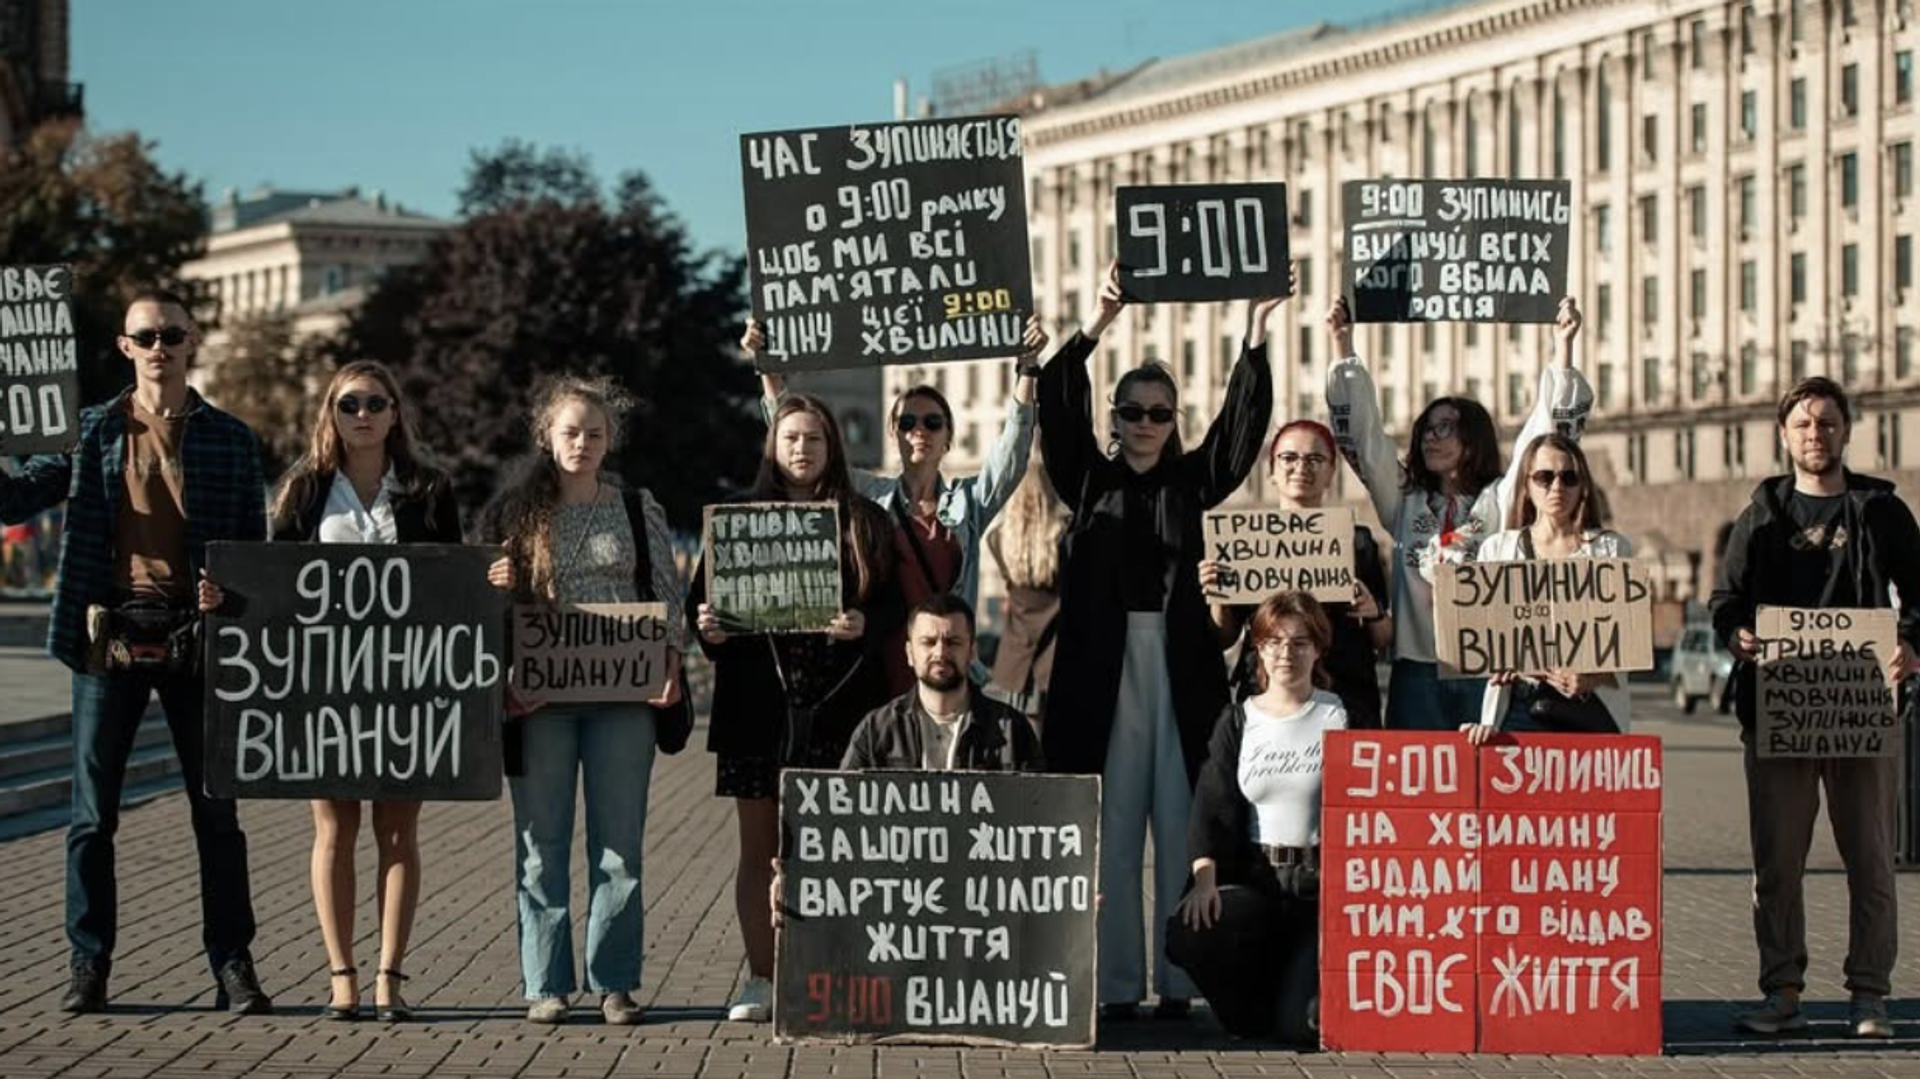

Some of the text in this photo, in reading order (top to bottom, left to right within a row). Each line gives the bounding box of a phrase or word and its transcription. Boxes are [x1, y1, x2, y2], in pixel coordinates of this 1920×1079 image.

[750, 118, 1023, 179] ЧАС ЗУПИНЯЄТЬСЯ
[838, 177, 911, 228] 9:00
[1361, 184, 1569, 225] 9:00 ЗУПИНИСЬ
[758, 241, 821, 277] ЩОБ
[833, 233, 888, 268] МИ
[1129, 198, 1268, 278] 9:00
[1352, 226, 1552, 263] ВШАНУЙ ВСІХ
[1355, 261, 1550, 295] КОГО ВБИЛА
[943, 289, 1011, 315] 9:00
[1409, 295, 1494, 320] РОСІЯ
[767, 312, 1021, 362] ЦІНУ ХВИЛИНИ
[711, 510, 822, 539] ТРИВАЄ
[1208, 512, 1325, 535] ТРИВАЄ
[1215, 538, 1341, 562] ХВИЛИНА
[296, 556, 411, 624] 9:00
[1217, 566, 1351, 594] МОВЧАННЯ
[1453, 560, 1647, 607] ЗУПИНИСЬ
[520, 613, 667, 648] ЗУПИНИСЬ
[1790, 611, 1852, 630] 9:00
[215, 623, 500, 701] ЗУПИНИСЬ
[1459, 614, 1621, 675] ВШАНУЙ
[1758, 636, 1877, 660] ТРИВАЄ
[522, 651, 650, 690] ВШАНУЙ
[1763, 664, 1885, 684] ХВИЛИНА
[1765, 687, 1894, 707] МОВЧАННЯ
[236, 696, 461, 781] ВШАНУЙ
[1767, 709, 1894, 731] ЗУПИНИСЬ
[1264, 750, 1297, 761] am
[1770, 730, 1882, 755] ВШАНУЙ
[1347, 741, 1661, 797] 9:00 ЗУПИНИСЬ
[796, 777, 995, 815] ХВИЛИНА
[799, 821, 1082, 863] ВАШОГО ЖИТТЯ
[1346, 811, 1616, 851] НА ХВИЛИНУ
[1345, 851, 1620, 899] ВІДДАЙ ШАНУ
[799, 875, 1088, 918] ВАРТУЄ ЦІЛОГО
[865, 921, 1010, 963] ЖИТТЯ
[806, 971, 1068, 1028] 9:00 ВШАНУЙ
[1348, 943, 1639, 1018] СВОЄ ЖИТТЯ
